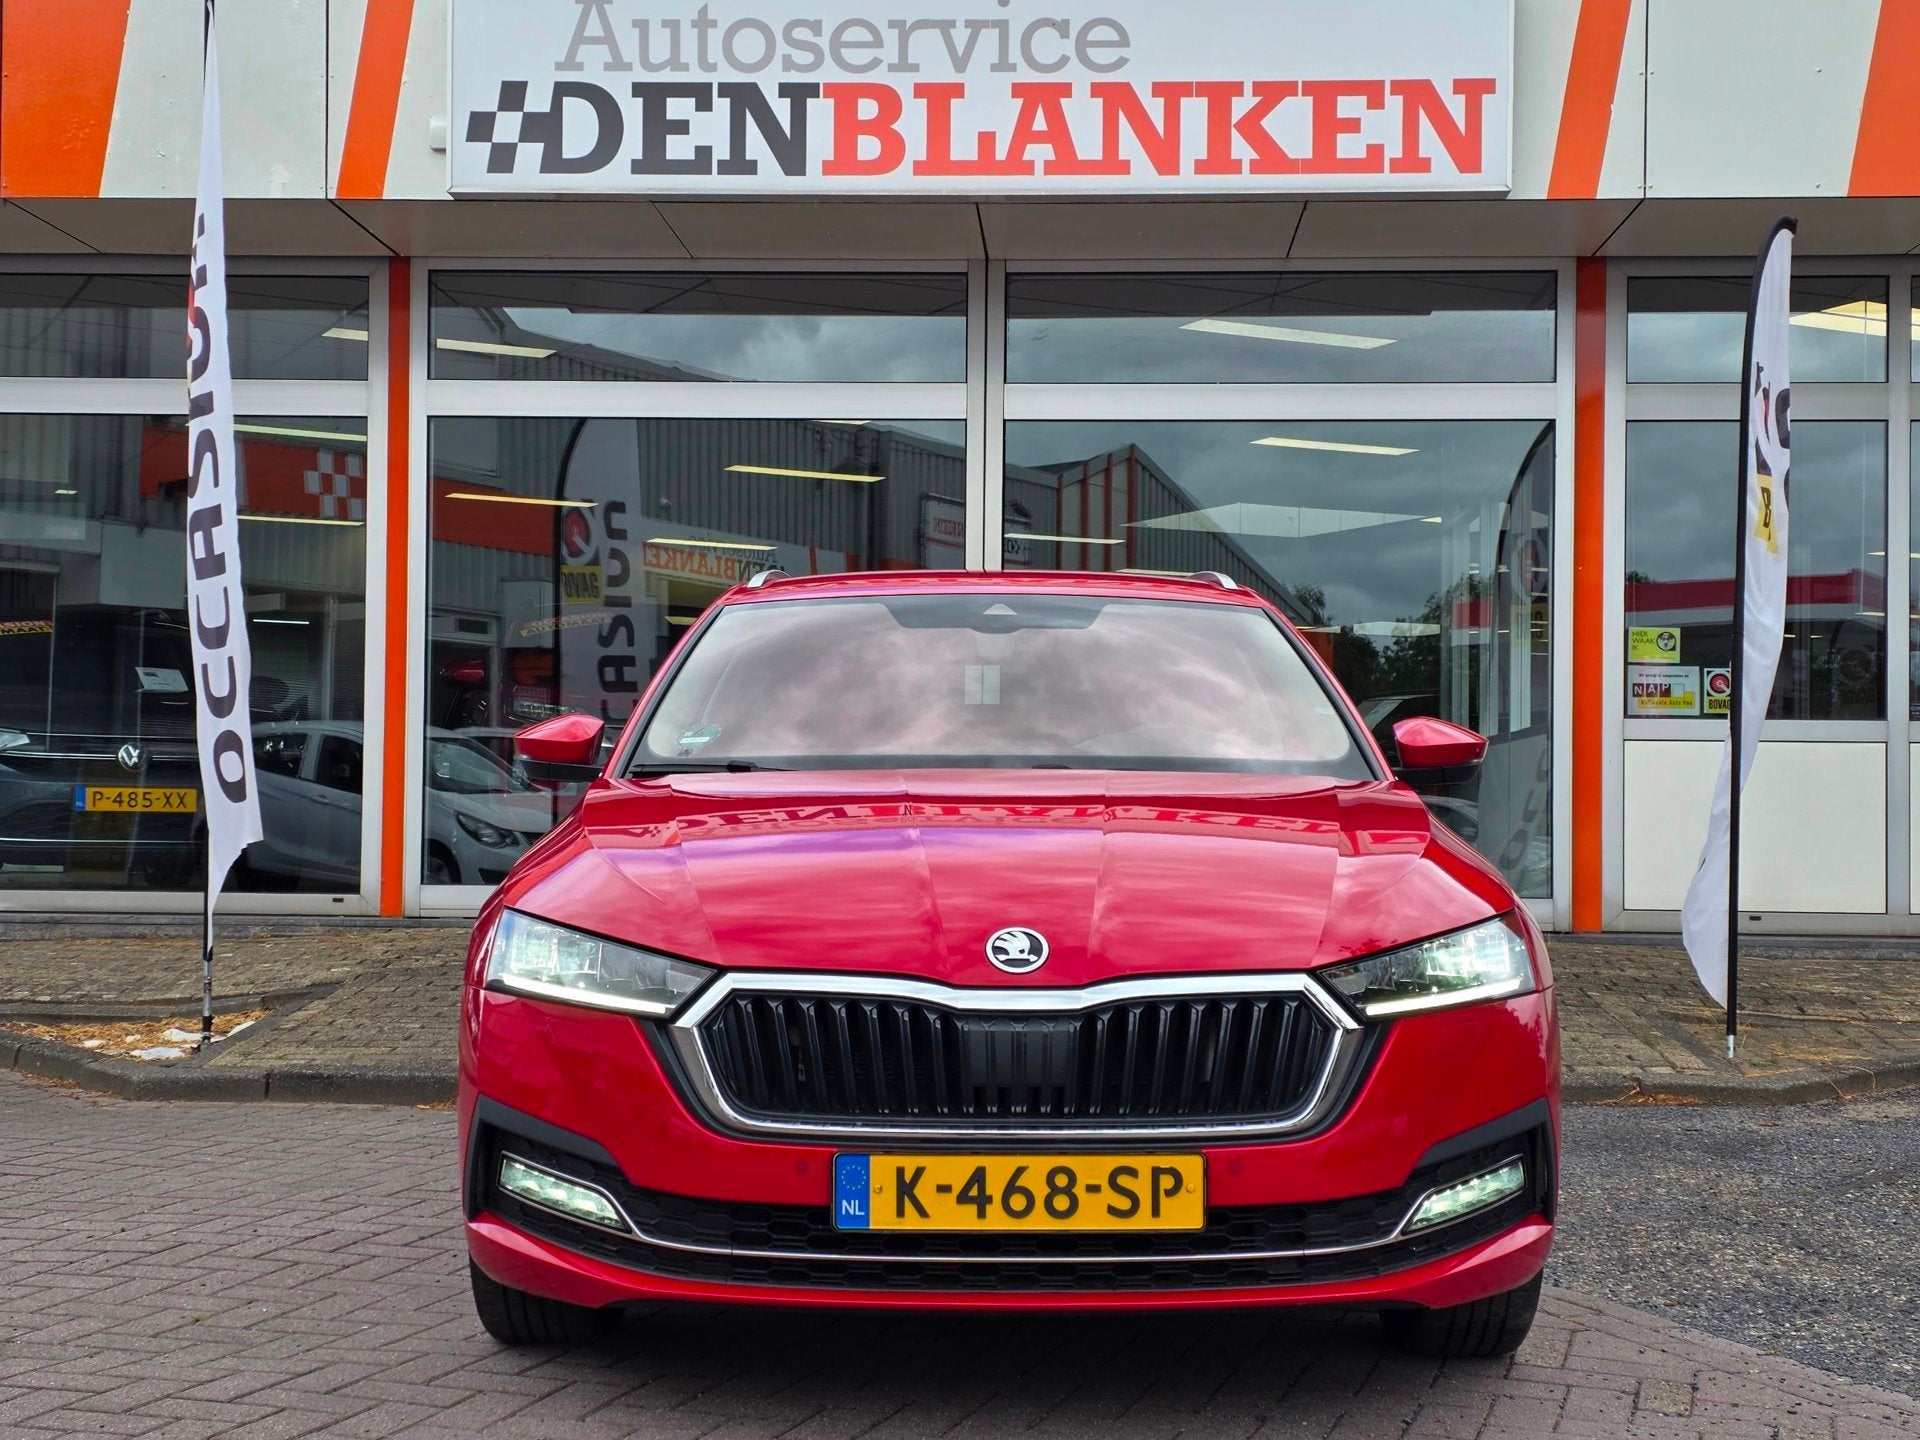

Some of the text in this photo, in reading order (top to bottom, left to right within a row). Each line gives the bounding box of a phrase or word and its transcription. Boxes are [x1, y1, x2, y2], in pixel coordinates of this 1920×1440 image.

[554, 0, 1131, 74] Autoservice
[92, 790, 188, 809] P-485-XX
[842, 1165, 1184, 1219] NL K-468-SP
